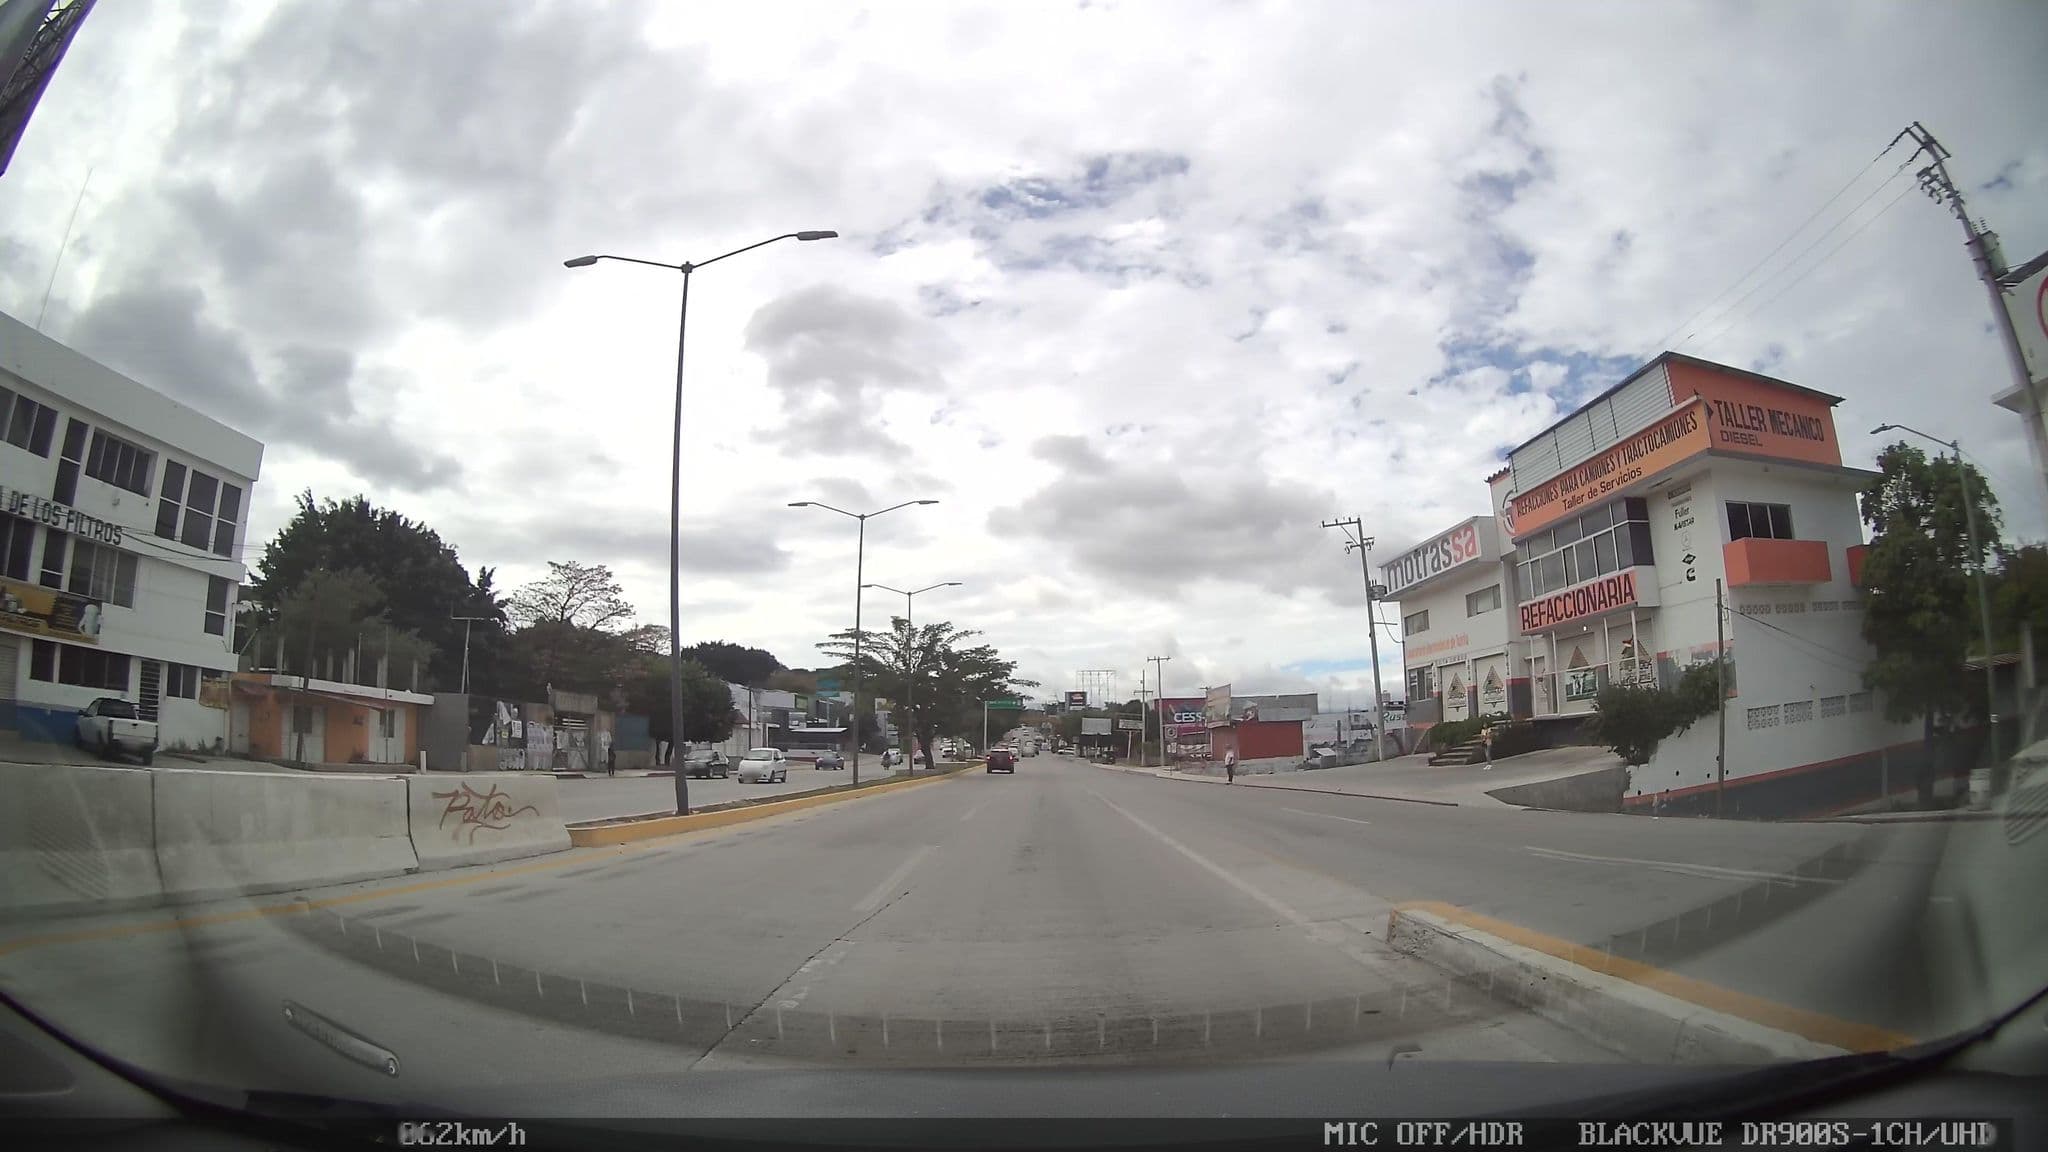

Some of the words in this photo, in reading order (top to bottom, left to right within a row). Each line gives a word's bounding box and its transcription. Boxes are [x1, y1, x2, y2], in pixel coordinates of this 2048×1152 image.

[1714, 400, 1767, 433] TALLER
[1768, 408, 1825, 442] MECANICO
[1720, 430, 1763, 447] DIESEL
[1516, 480, 1560, 518] REFACCIONES
[1560, 472, 1580, 497] PARA
[1579, 455, 1616, 487] CAMIONES
[1616, 453, 1623, 469] Y
[1622, 411, 1698, 466] TRACTOCAMIONES
[1562, 494, 1585, 512] Taller
[1587, 485, 1599, 500] de
[1600, 466, 1642, 493] Servicios
[9, 490, 29, 516] DE
[32, 497, 62, 527] LOS
[66, 509, 124, 546] FILTROS
[1387, 525, 1478, 592] motrassa
[1521, 573, 1635, 630] REFACCIONARIA
